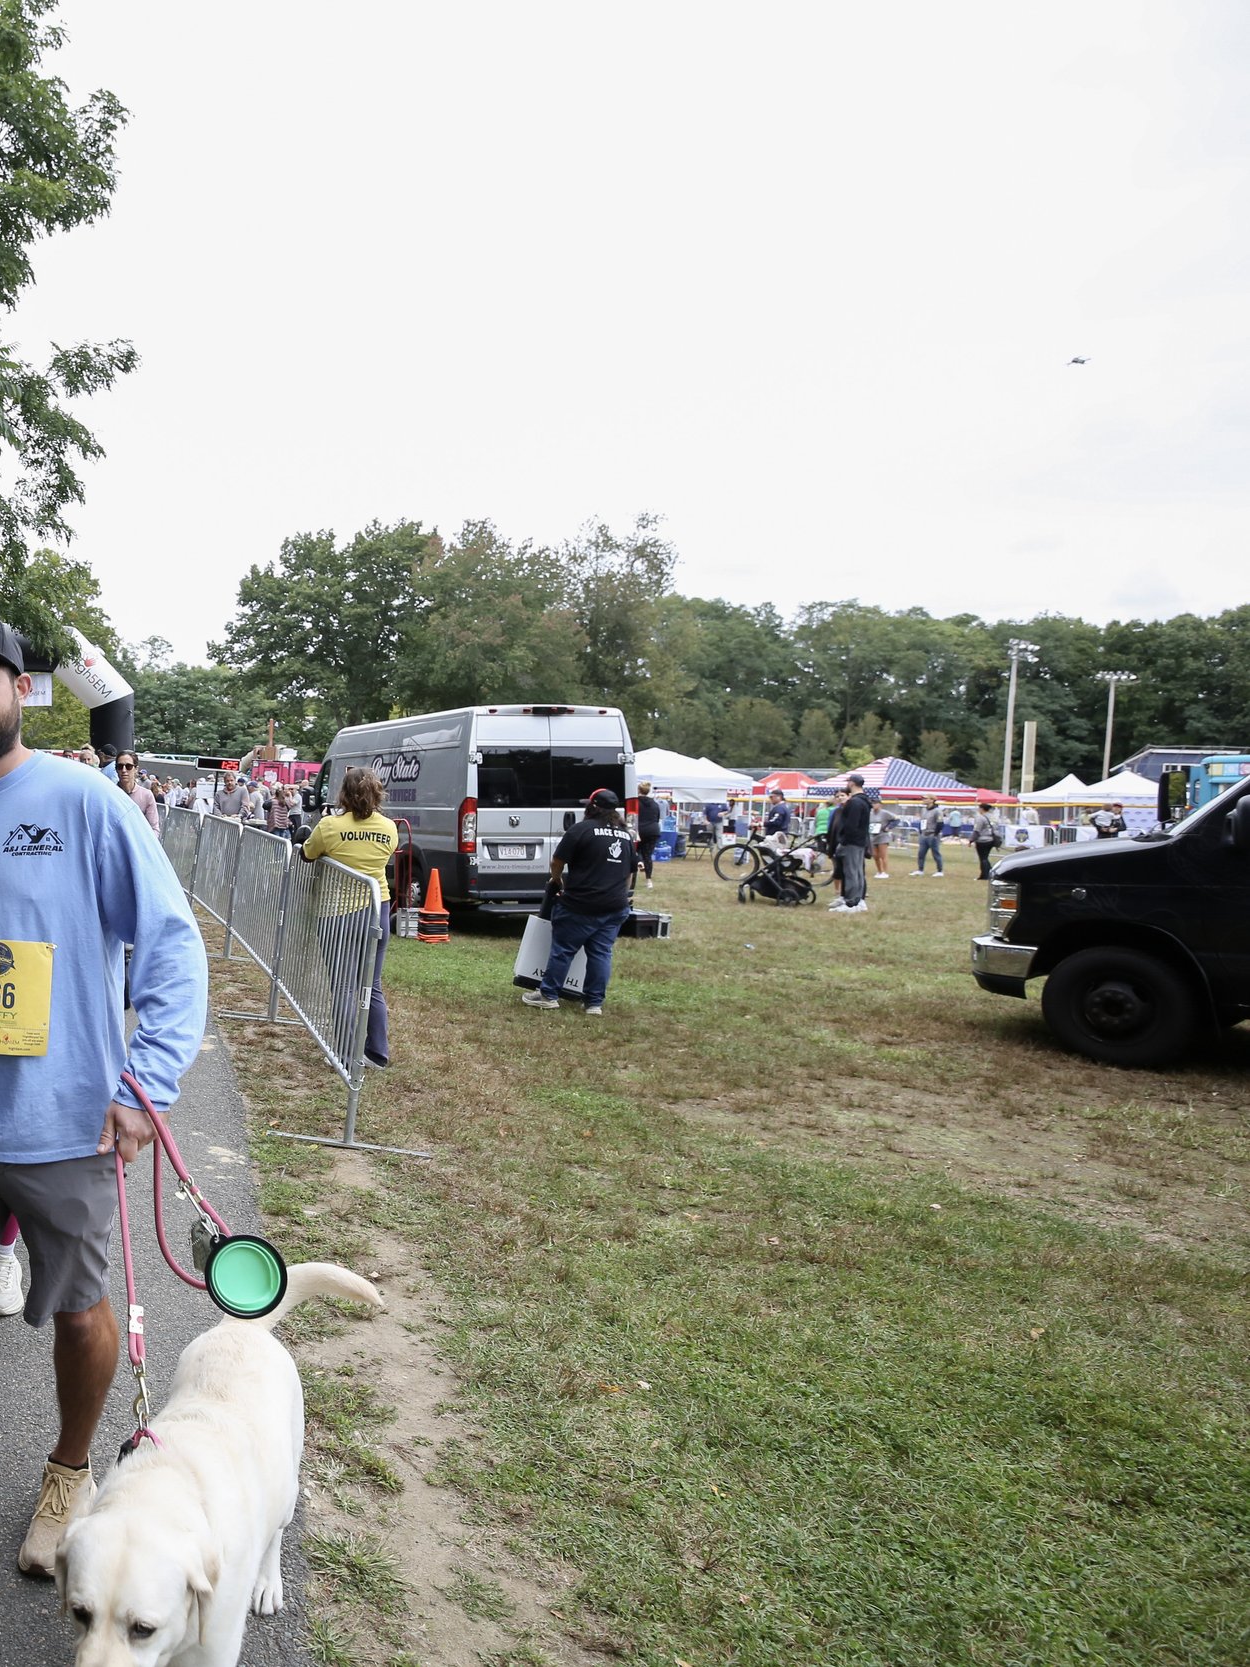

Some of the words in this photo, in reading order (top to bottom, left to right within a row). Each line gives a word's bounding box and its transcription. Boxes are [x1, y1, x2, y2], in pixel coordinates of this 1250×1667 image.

[221, 760, 239, 771] 1:25
[391, 753, 420, 782] State
[340, 831, 392, 845] VOLUNTEER
[593, 828, 614, 837] RACE
[2, 845, 20, 853] A&J
[20, 844, 64, 852] GENERAL
